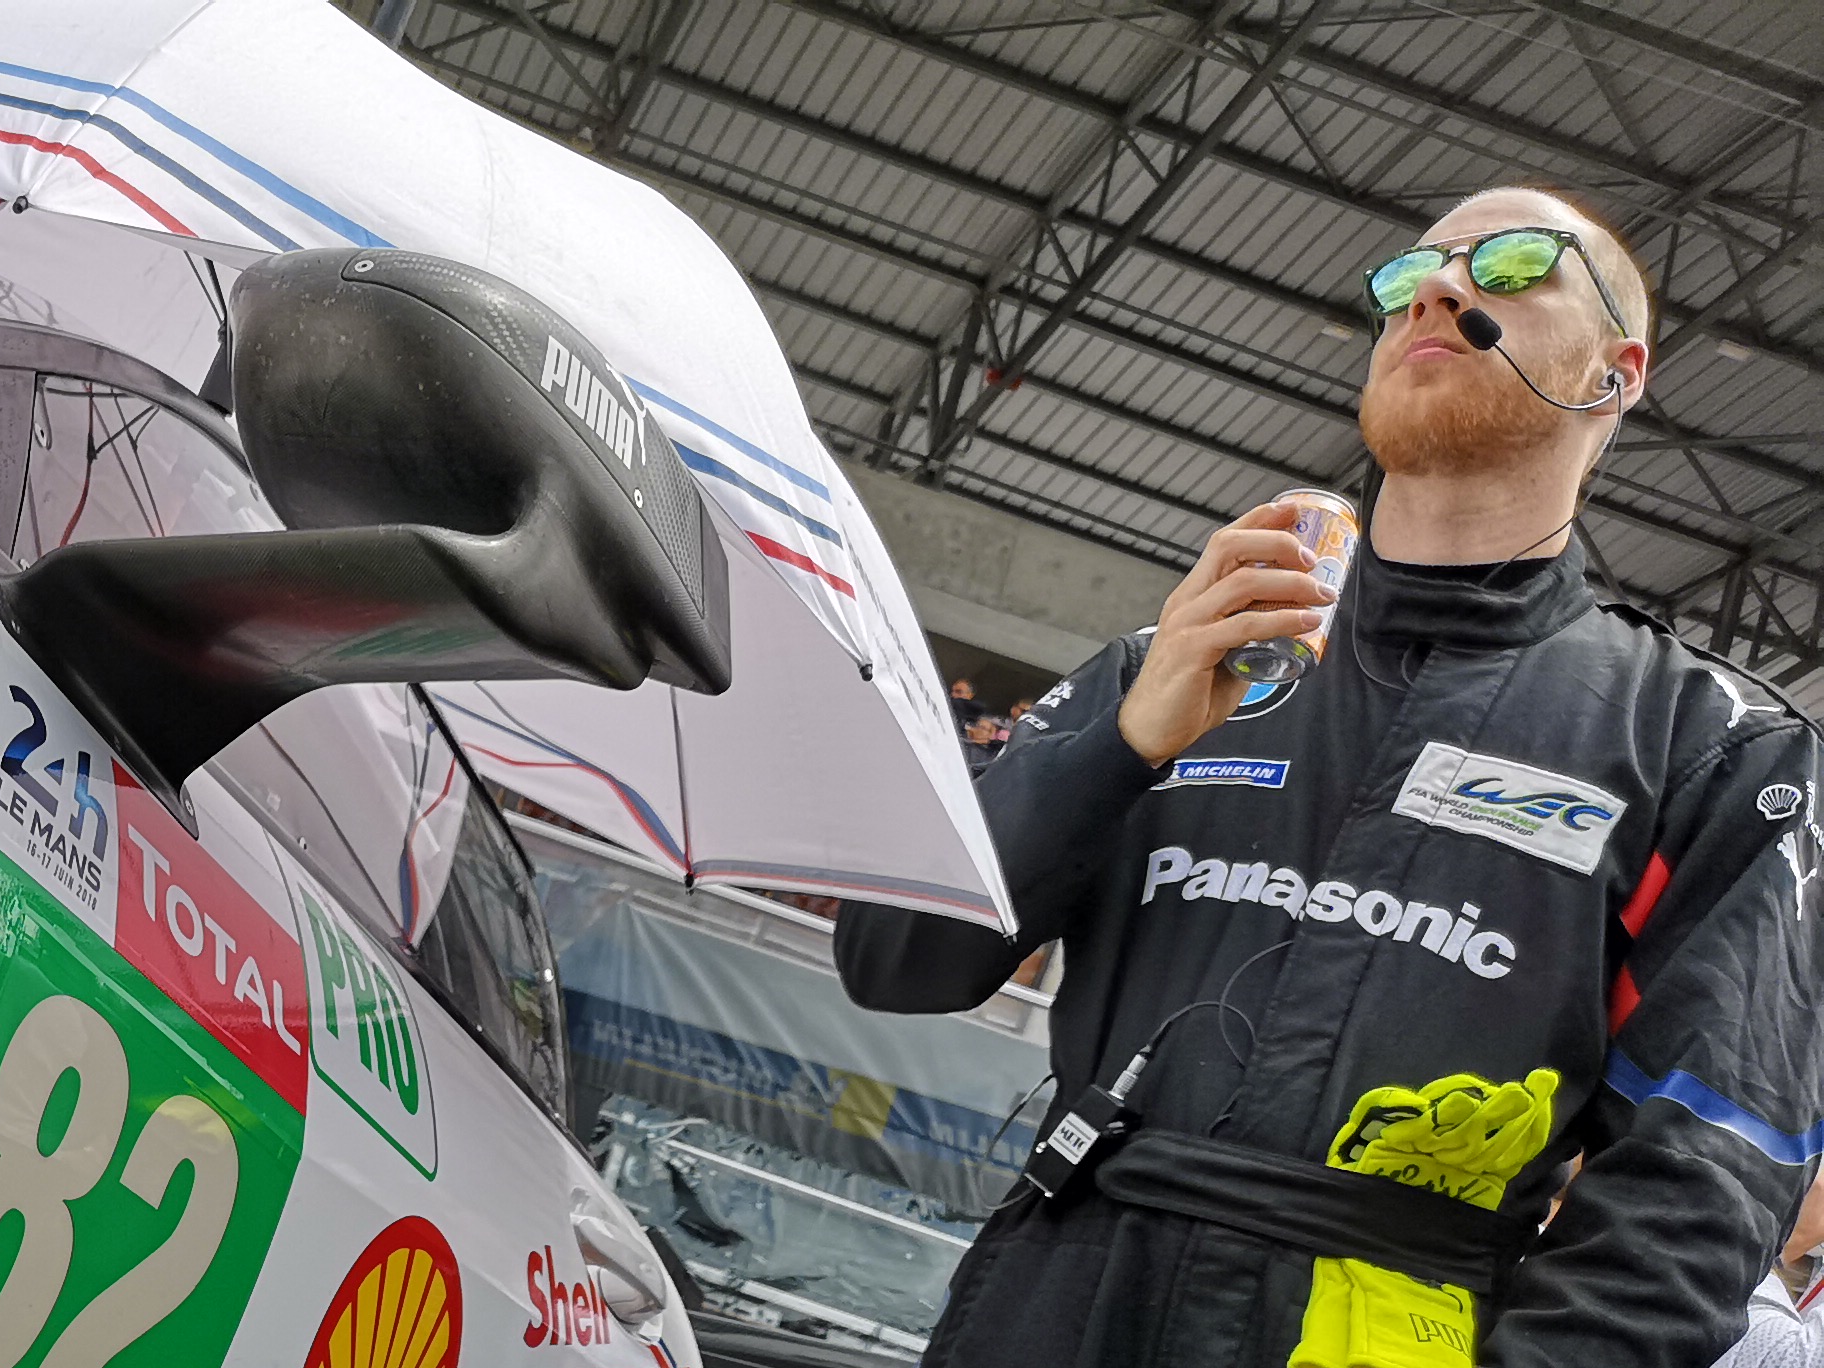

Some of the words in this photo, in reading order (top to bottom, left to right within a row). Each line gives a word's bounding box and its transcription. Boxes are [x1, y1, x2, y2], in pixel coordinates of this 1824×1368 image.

[540, 333, 637, 471] PUMA
[1, 684, 108, 862] 24h
[1184, 764, 1277, 779] MICHELIN
[1407, 787, 1428, 799] FIA
[1429, 794, 1469, 810] WORLD
[1469, 805, 1544, 832] ENDURANCE
[1453, 777, 1613, 832] WEC
[30, 810, 102, 893] MANS
[1449, 808, 1535, 837] CHAMPIONSHIP
[26, 839, 51, 869] 16-17
[53, 863, 74, 892] JUIN
[76, 884, 98, 911] 2018
[1140, 845, 1518, 982] Panasonic
[127, 824, 301, 1056] TOTAL
[296, 880, 420, 1115] PRO
[523, 1245, 612, 1349] Shell
